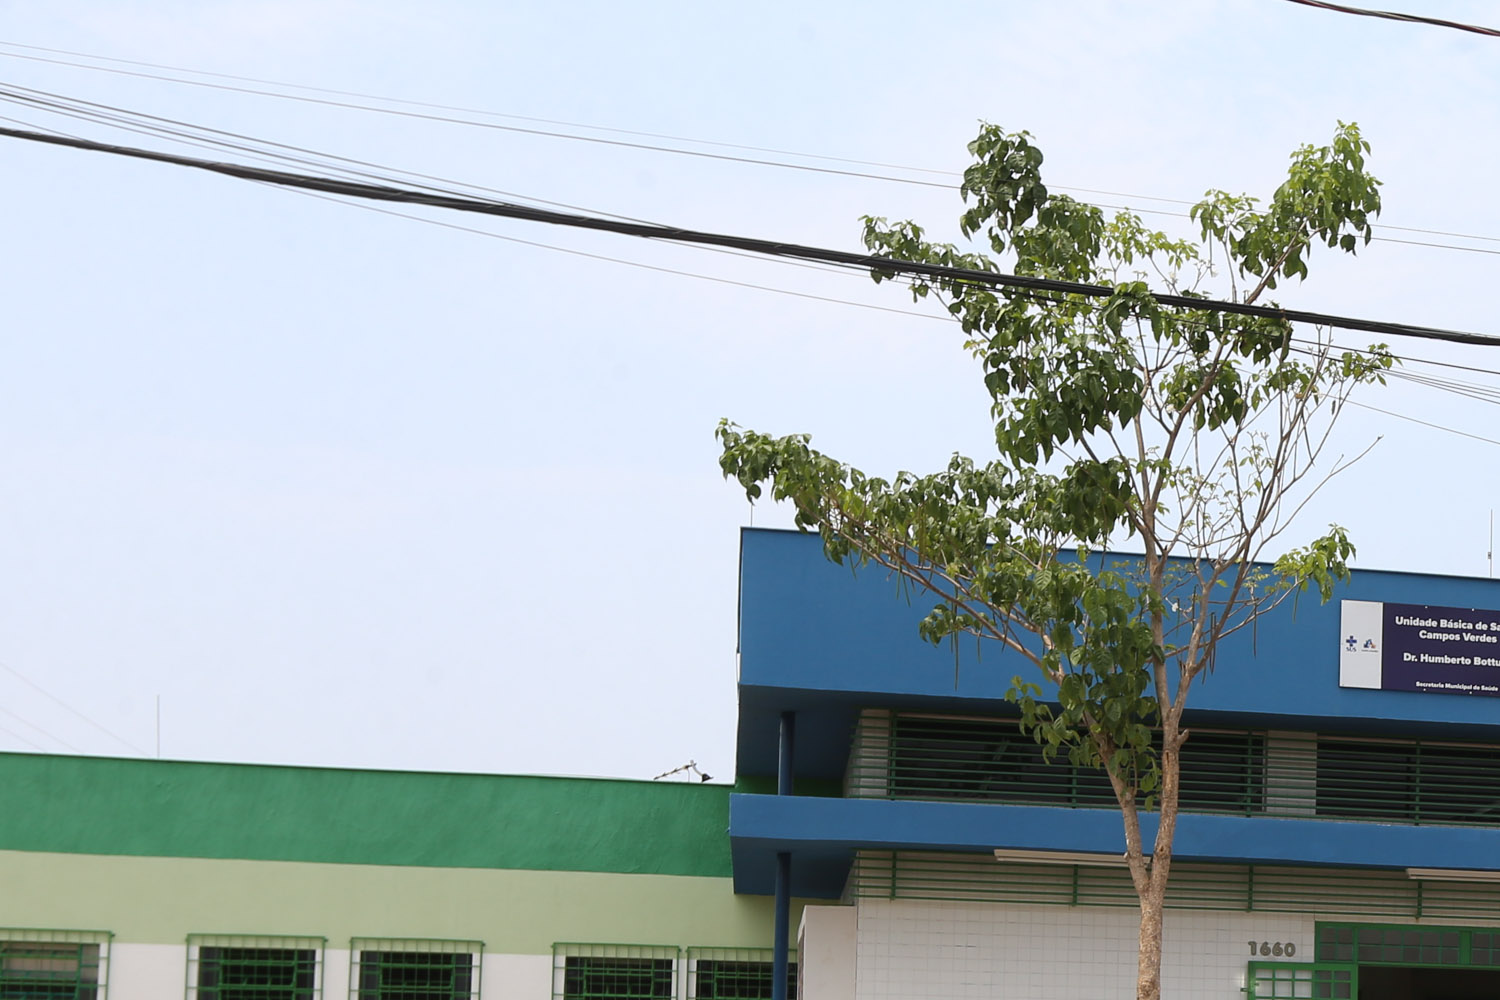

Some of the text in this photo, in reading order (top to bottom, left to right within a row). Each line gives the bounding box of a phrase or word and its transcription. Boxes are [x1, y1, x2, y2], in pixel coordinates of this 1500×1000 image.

[1395, 616, 1438, 628] Unidade
[1440, 619, 1473, 630] Básica
[1475, 621, 1488, 631] de
[1419, 630, 1498, 643] Campos Verdes
[1403, 652, 1418, 662] Dr.
[1420, 653, 1471, 666] Humberto
[1248, 941, 1296, 957] 1660
